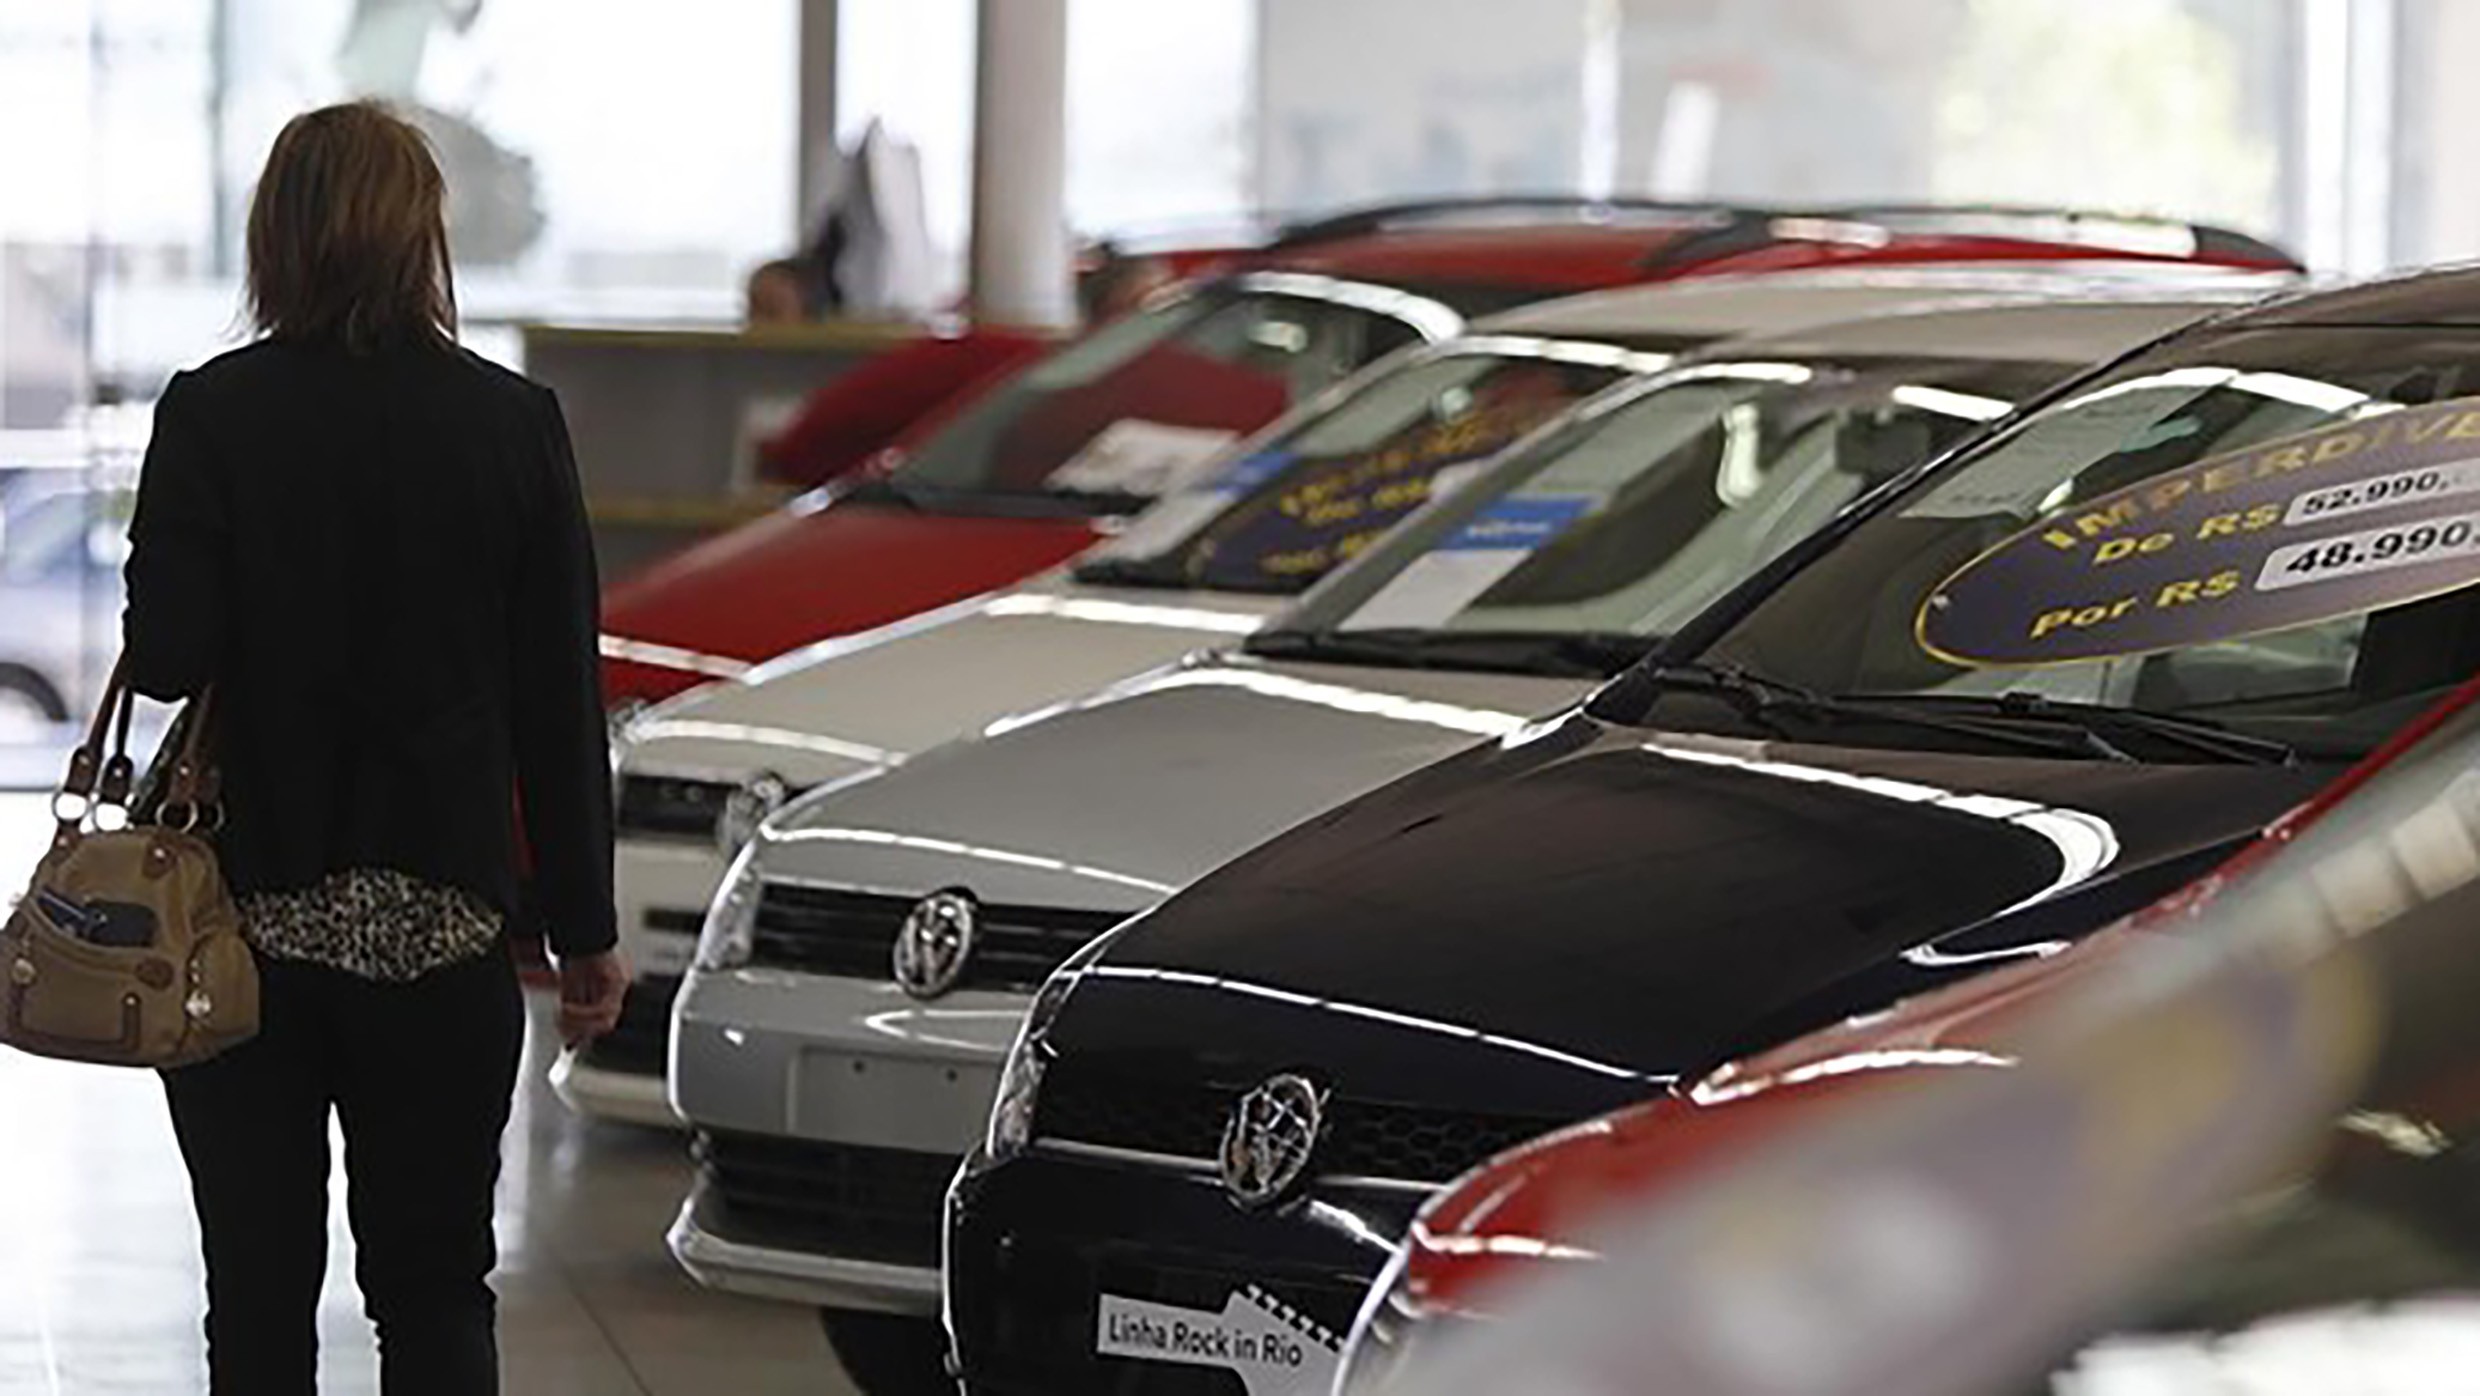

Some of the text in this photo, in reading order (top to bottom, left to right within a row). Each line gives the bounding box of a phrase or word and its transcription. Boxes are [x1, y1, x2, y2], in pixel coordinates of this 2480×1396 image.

[2092, 532, 2175, 566] De
[1109, 1313, 1304, 1367] Linha Rock in Rio
